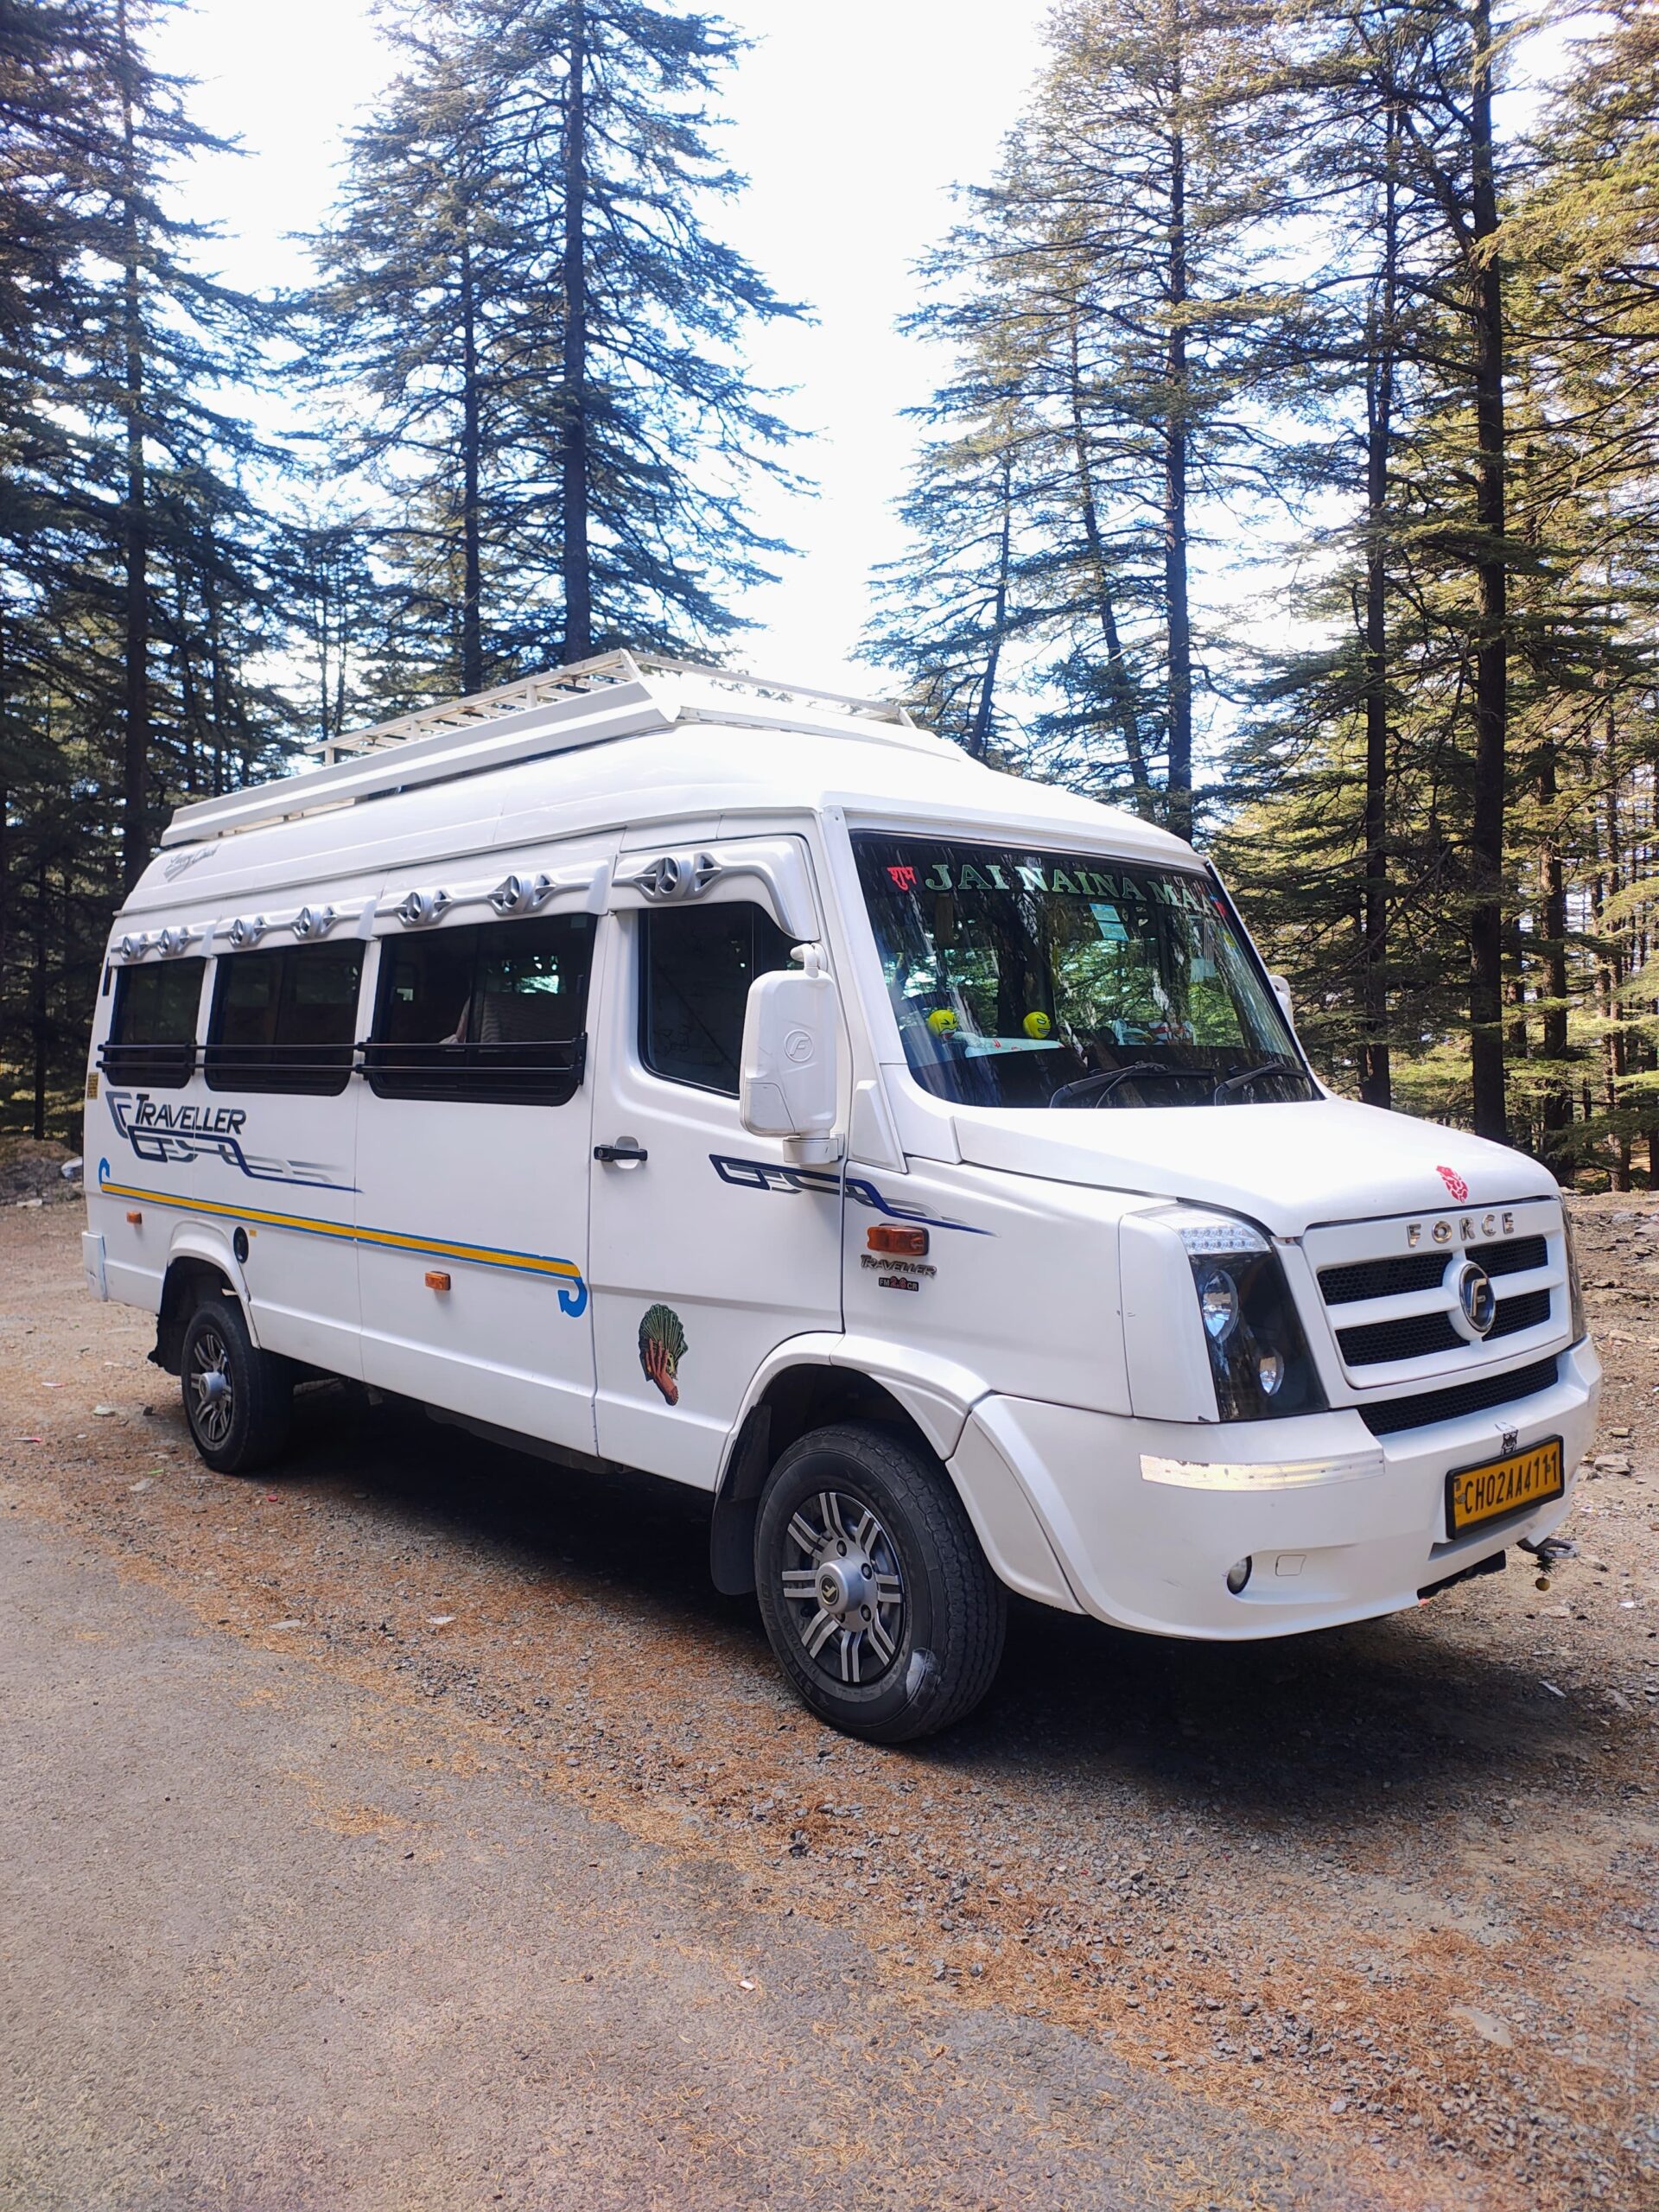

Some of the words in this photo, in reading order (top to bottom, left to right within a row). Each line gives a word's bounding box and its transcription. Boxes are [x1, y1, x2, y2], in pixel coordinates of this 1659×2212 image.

[925, 864, 1009, 891] JAI
[1014, 866, 1147, 901] NAINA
[1147, 880, 1221, 918] MAA
[135, 1093, 246, 1135] TRAVELLER
[1407, 1212, 1514, 1248] FORCE
[861, 1255, 938, 1277] TRAVELLER
[1465, 1451, 1557, 1514] CH02AA4111
